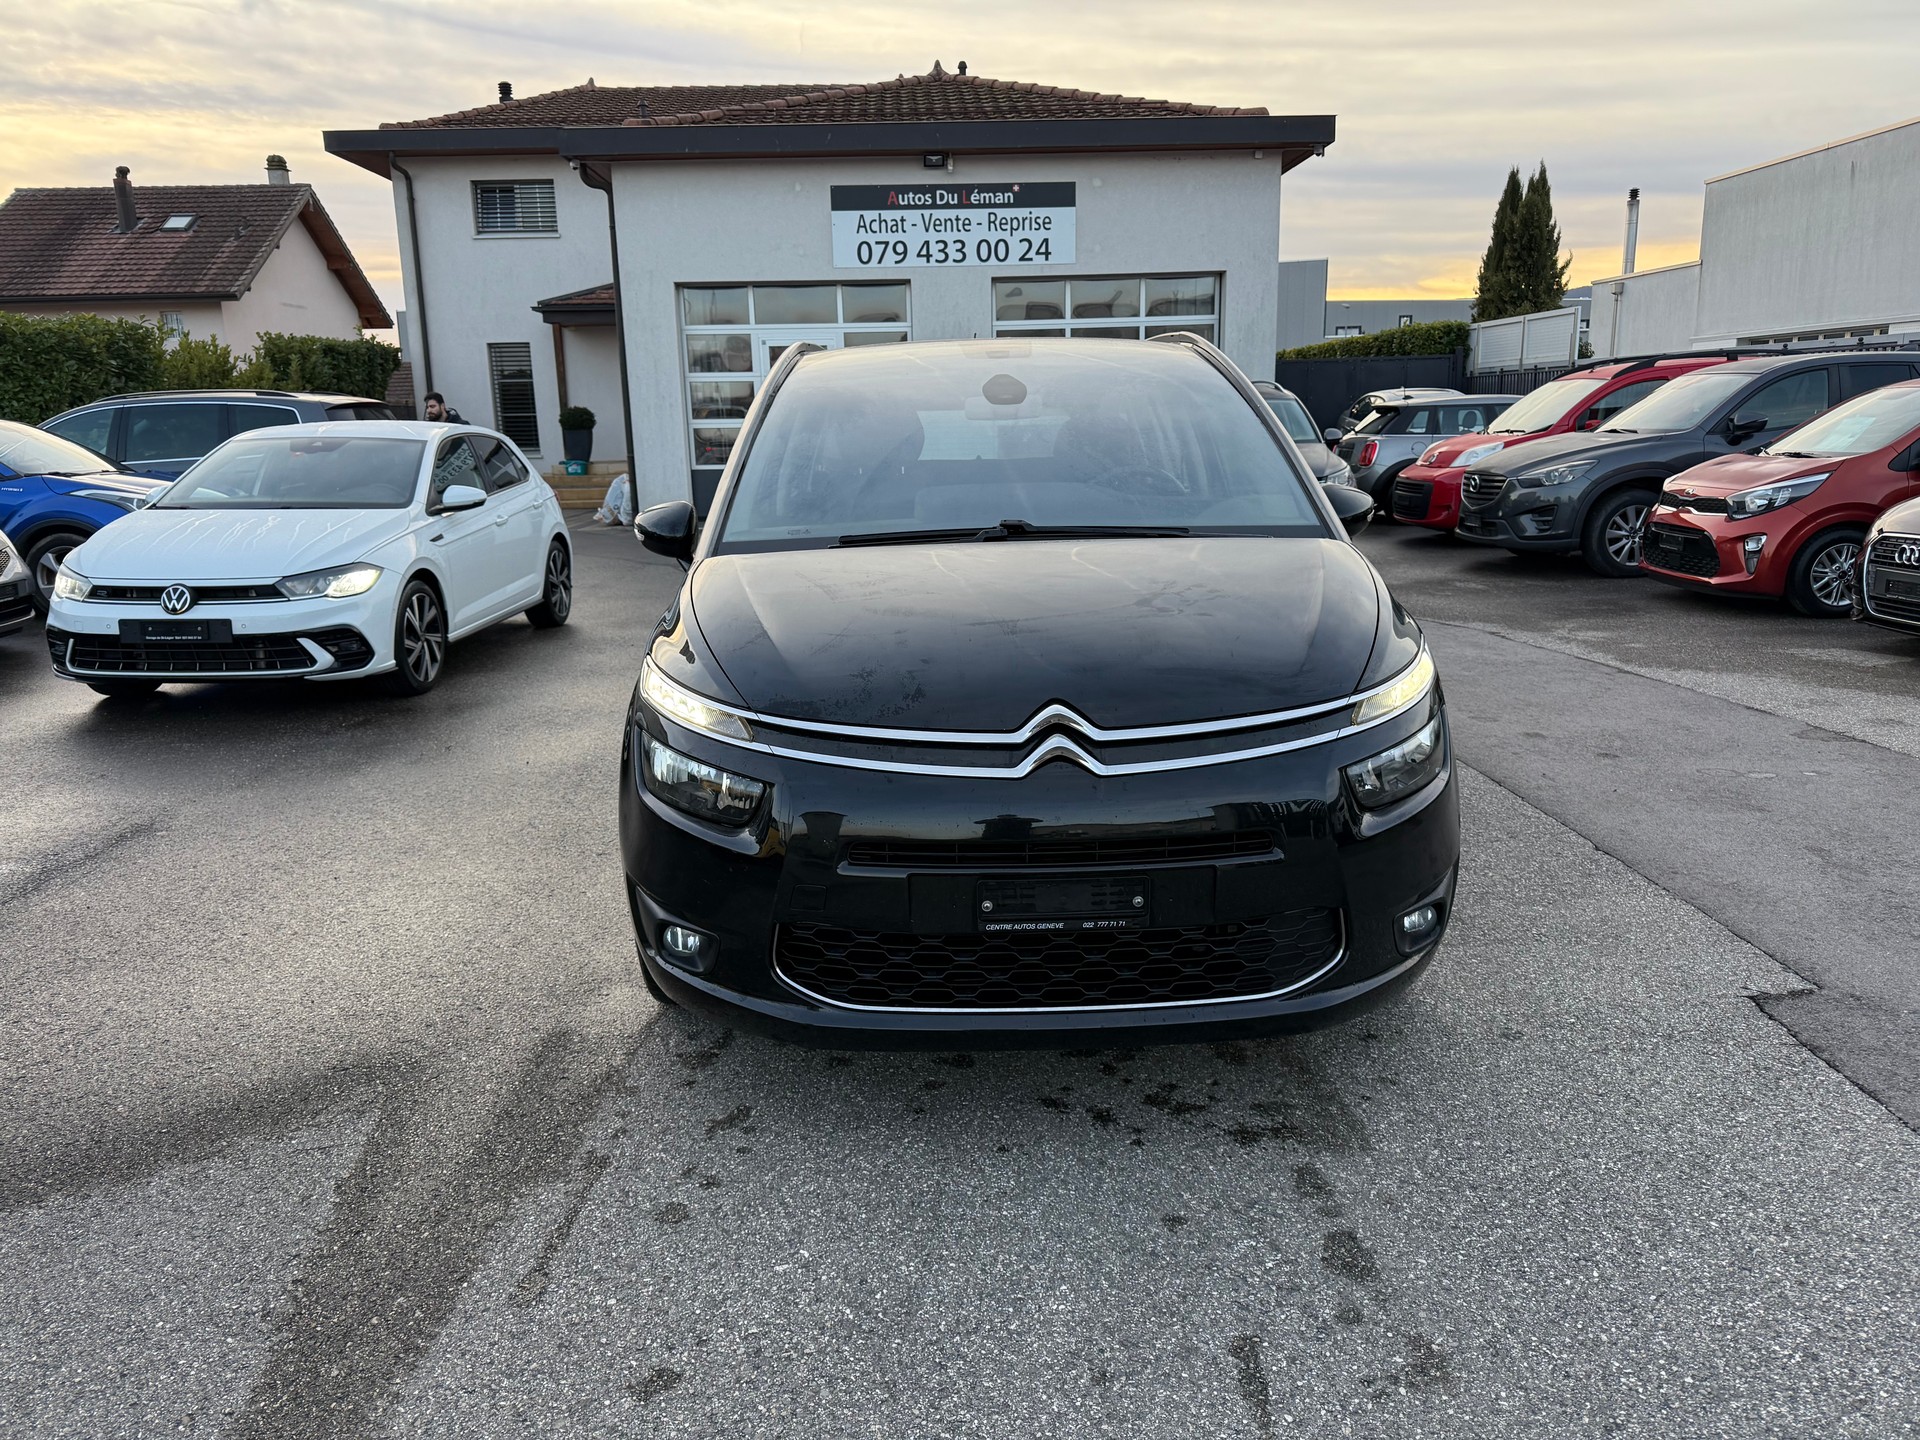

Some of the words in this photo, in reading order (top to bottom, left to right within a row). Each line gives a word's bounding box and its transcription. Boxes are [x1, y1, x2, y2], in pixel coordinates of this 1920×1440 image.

[887, 190, 932, 206] Autos
[936, 190, 958, 205] Du
[962, 188, 1014, 205] Léman
[856, 212, 907, 234] Achat
[920, 212, 972, 233] Vente
[988, 211, 1052, 237] Reprise
[856, 240, 908, 265] 079
[916, 239, 967, 264] 433
[976, 238, 1010, 263] 00
[1018, 237, 1052, 262] 24
[985, 923, 1012, 931] CENTRE
[1036, 922, 1064, 930] GENEVE
